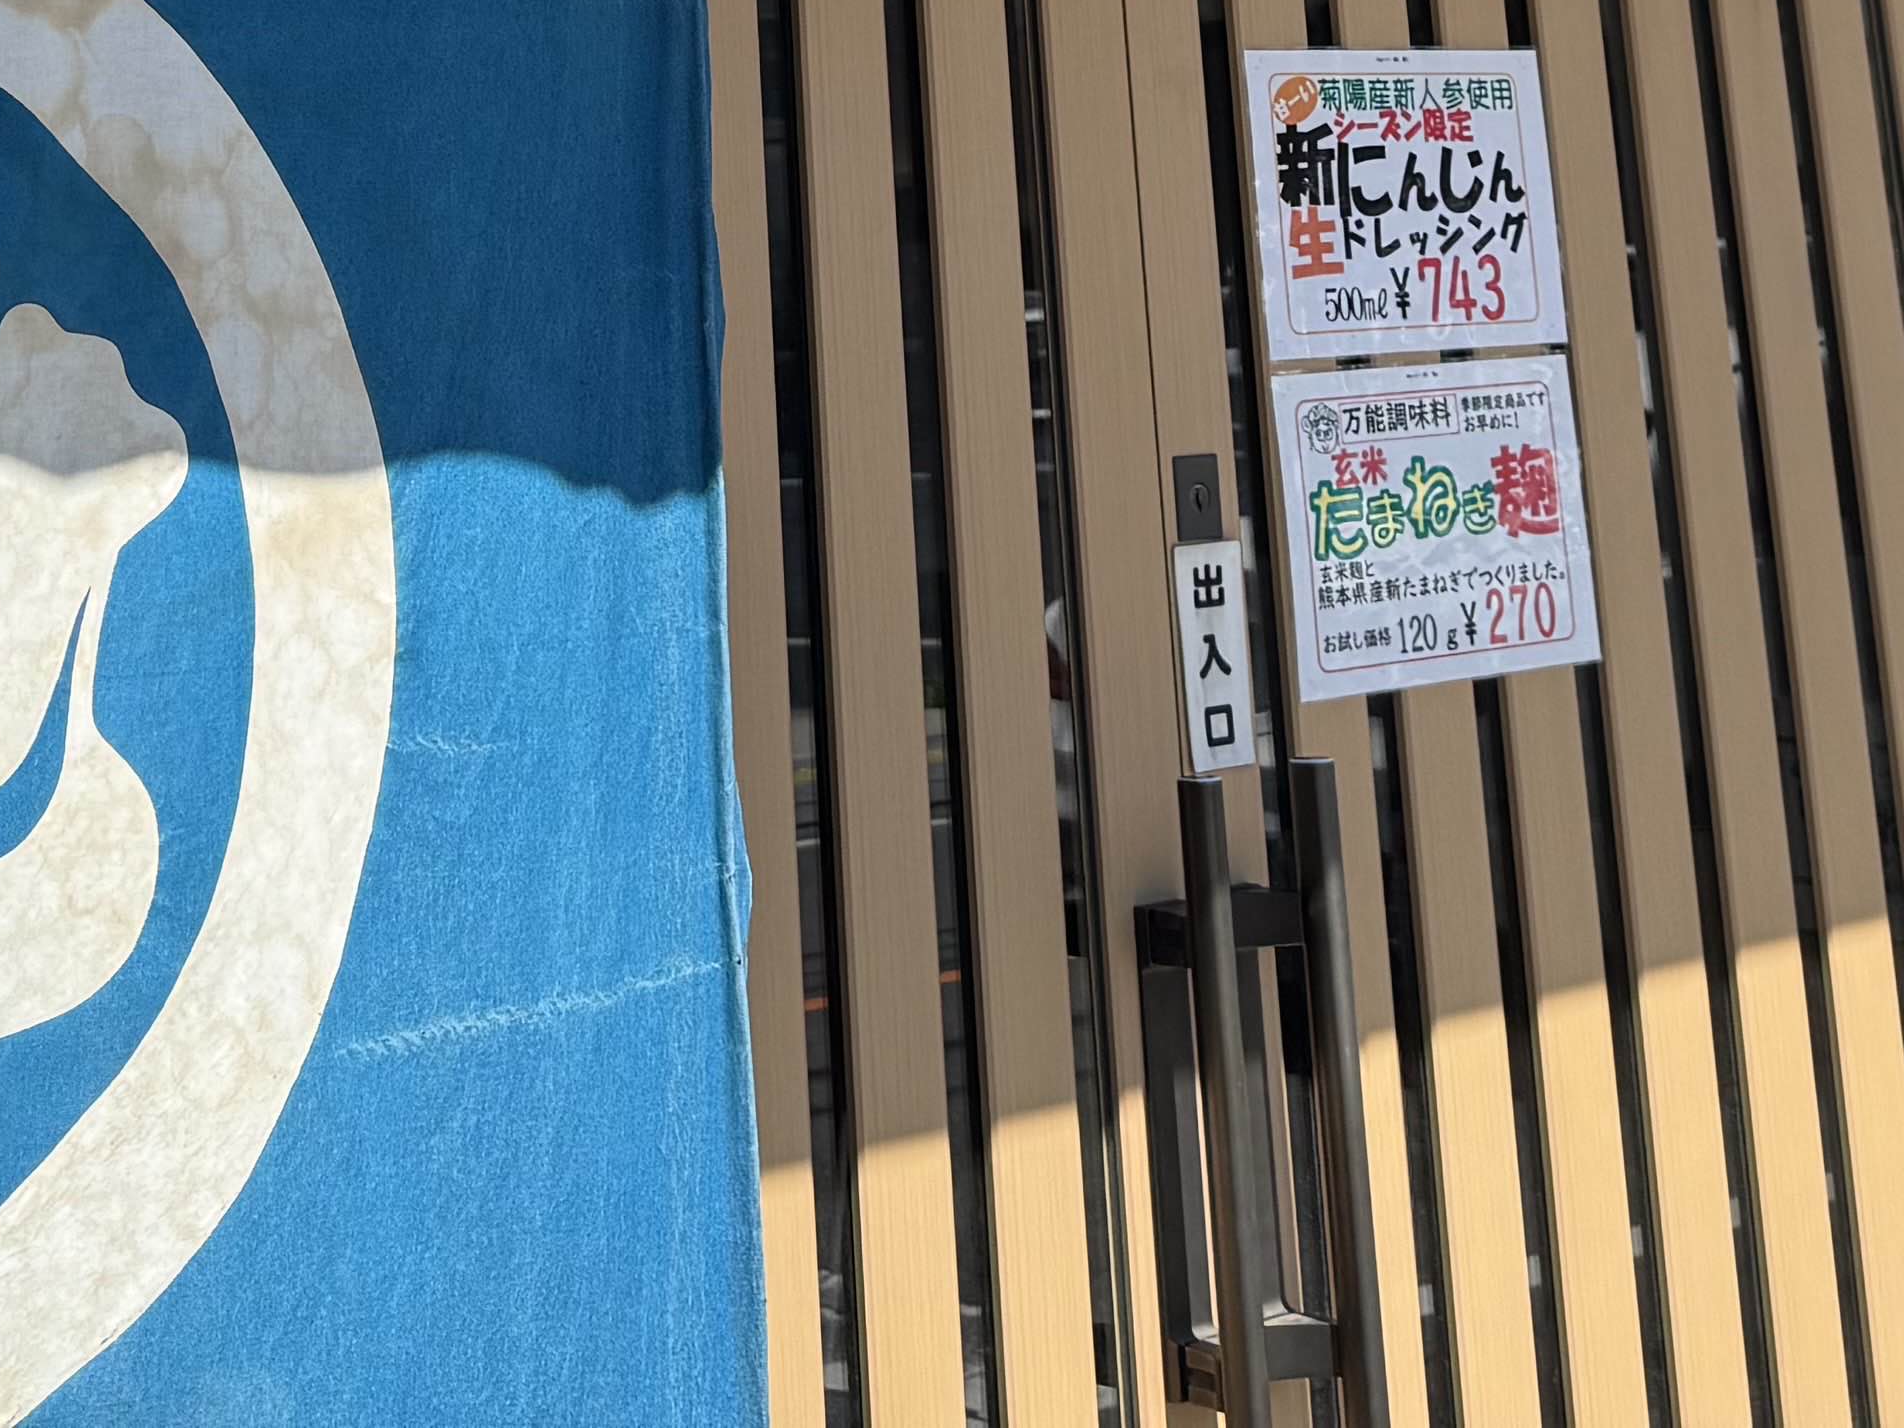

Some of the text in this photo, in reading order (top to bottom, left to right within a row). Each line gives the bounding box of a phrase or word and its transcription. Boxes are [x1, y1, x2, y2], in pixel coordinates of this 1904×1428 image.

[1318, 77, 1514, 112] 菊陽産新人参使用
[1334, 109, 1474, 143] シーズン限定
[1276, 124, 1525, 218] 新にんじん
[1342, 397, 1453, 435] 万能調味料
[1331, 446, 1389, 489] 玄米
[1192, 563, 1236, 748] 出入口
[1323, 627, 1393, 654] お試し価格
